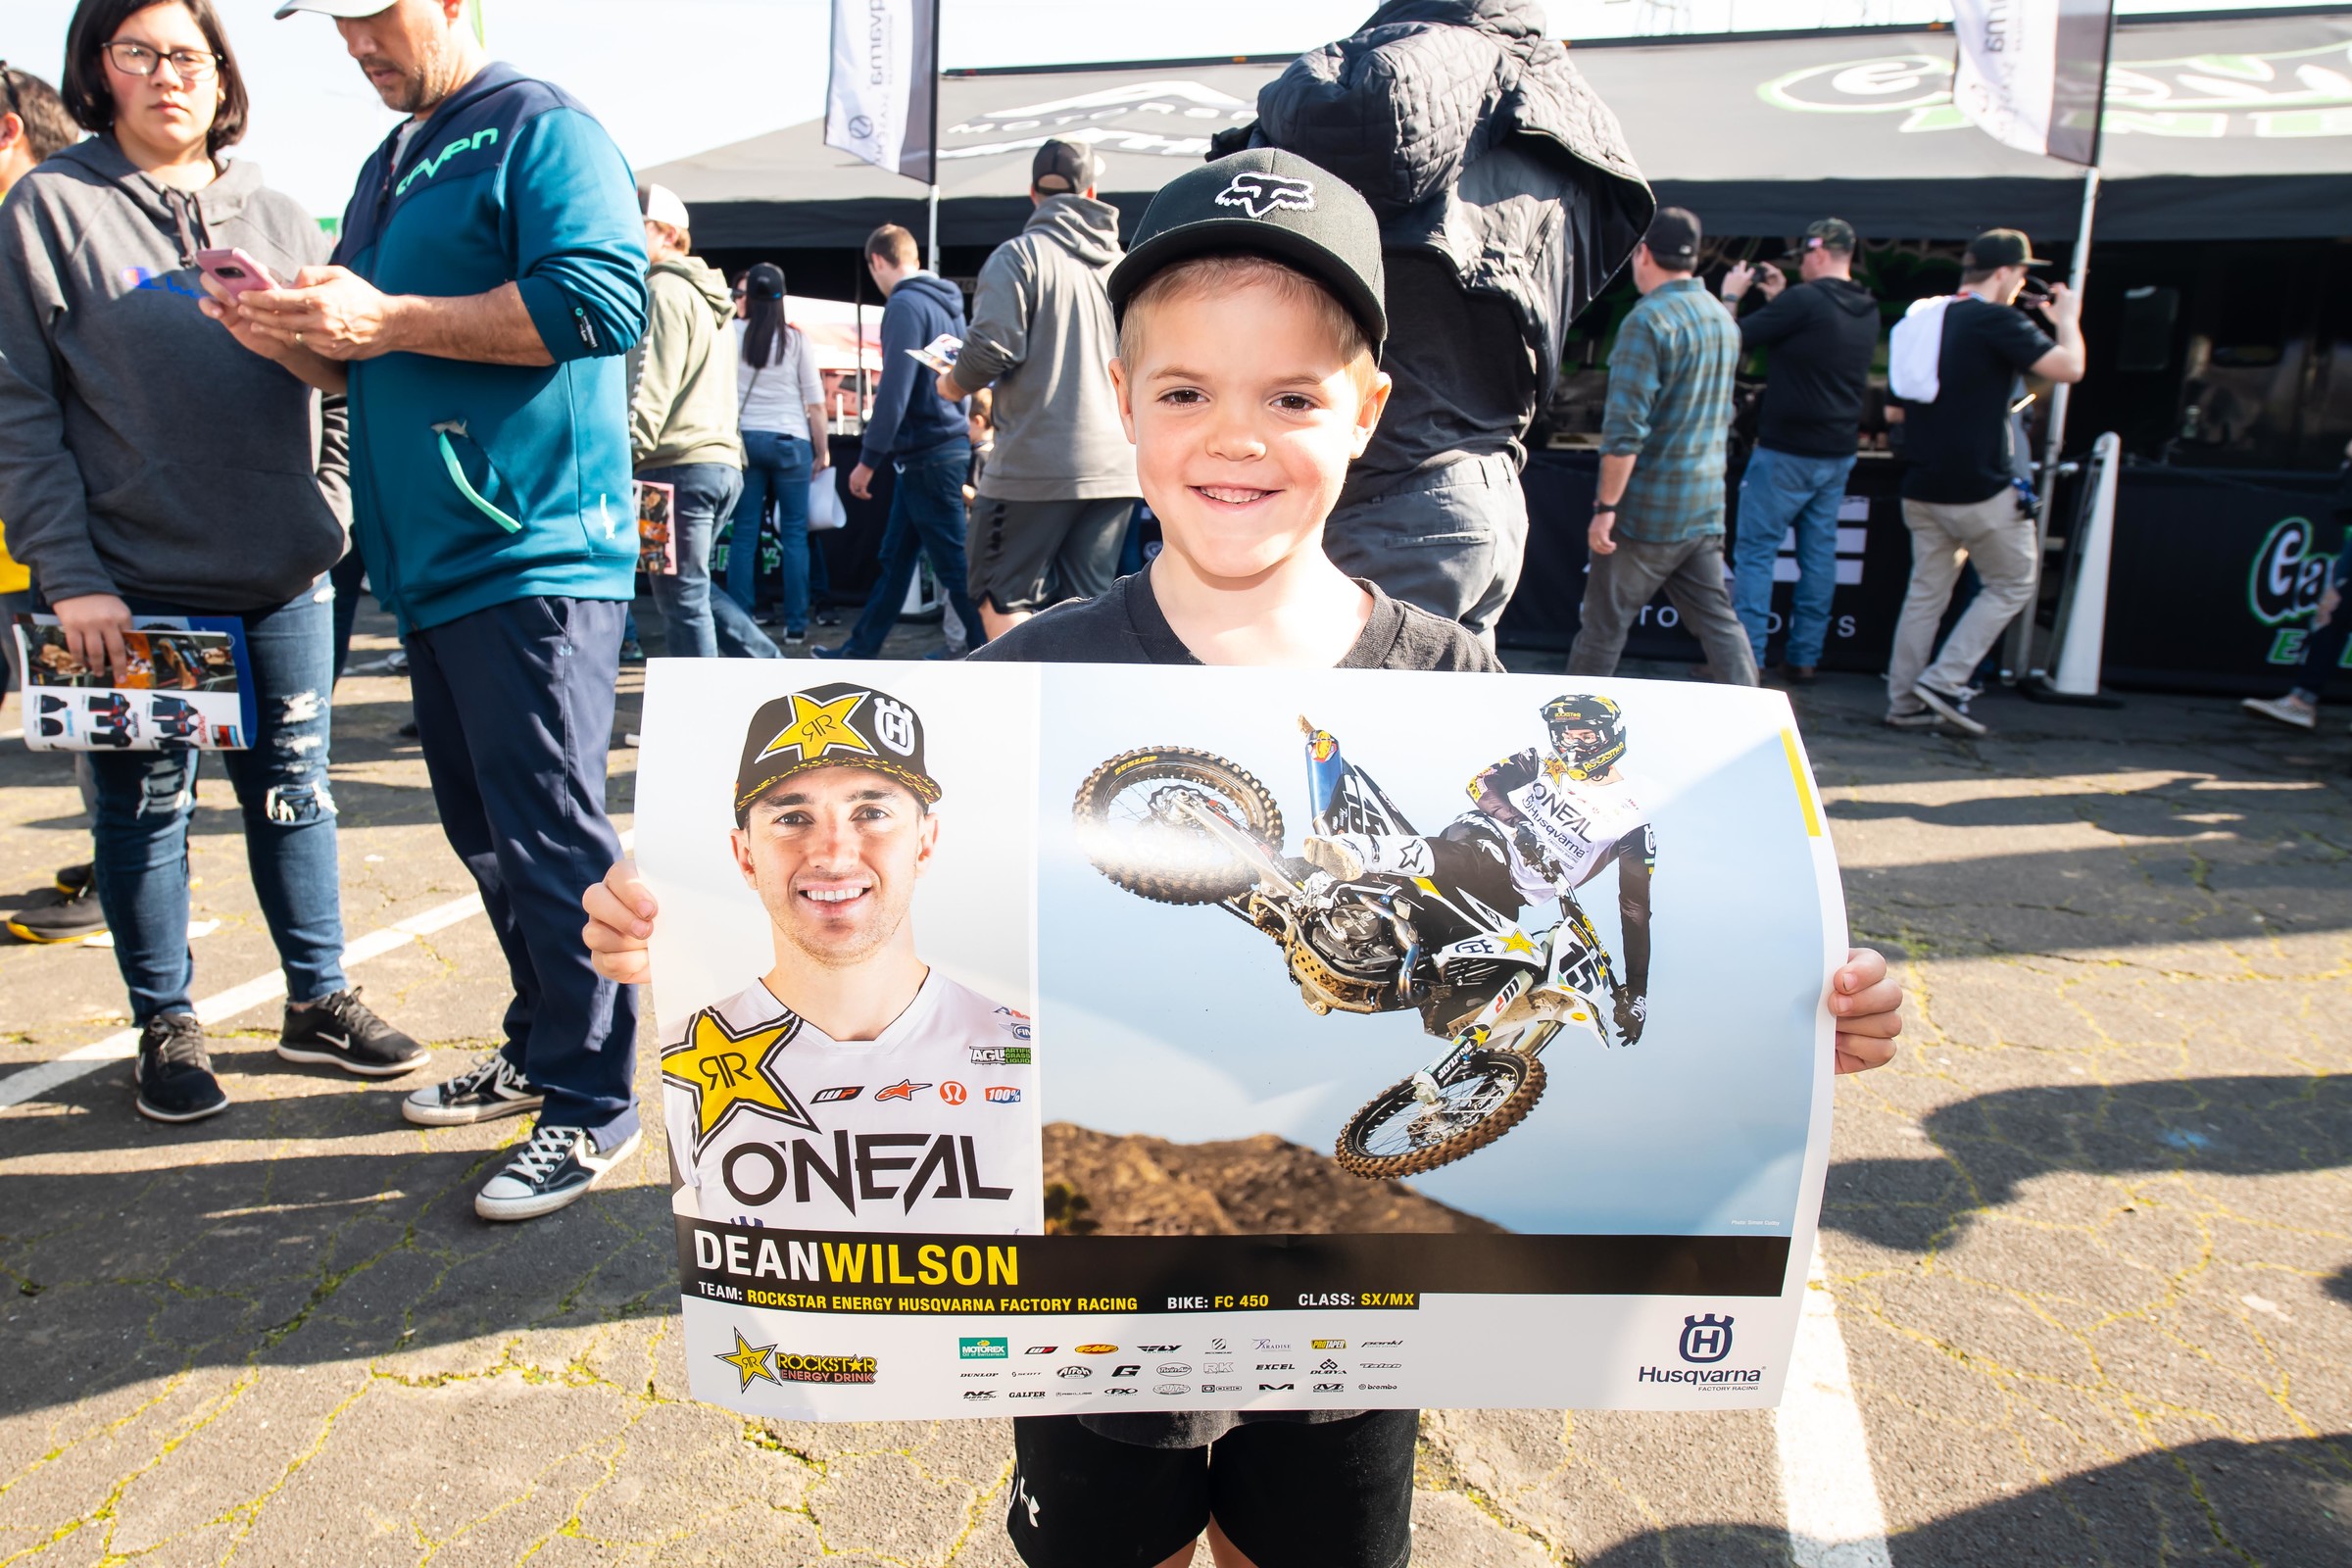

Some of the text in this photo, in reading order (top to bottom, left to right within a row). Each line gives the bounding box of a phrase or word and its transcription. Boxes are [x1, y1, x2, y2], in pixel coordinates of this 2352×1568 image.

[1114, 756, 1158, 775] DUNLOP
[1528, 805, 1588, 859] Husqvarna
[1558, 941, 1601, 996] 15
[987, 1089, 1021, 1102] 100%
[721, 1129, 1014, 1217] O'NEAL
[698, 1280, 1138, 1313] TEAM: ROCKSTAR ENERGY HUSQVARNA FACTORY RACING
[1167, 1294, 1269, 1309] BIKE: FC 450
[1298, 1292, 1415, 1306] CLASS: SX/MX
[777, 1353, 876, 1372] ROCKSTAR
[781, 1369, 875, 1384] ENERGY DRINK
[1638, 1366, 1762, 1385] Husqvarna
